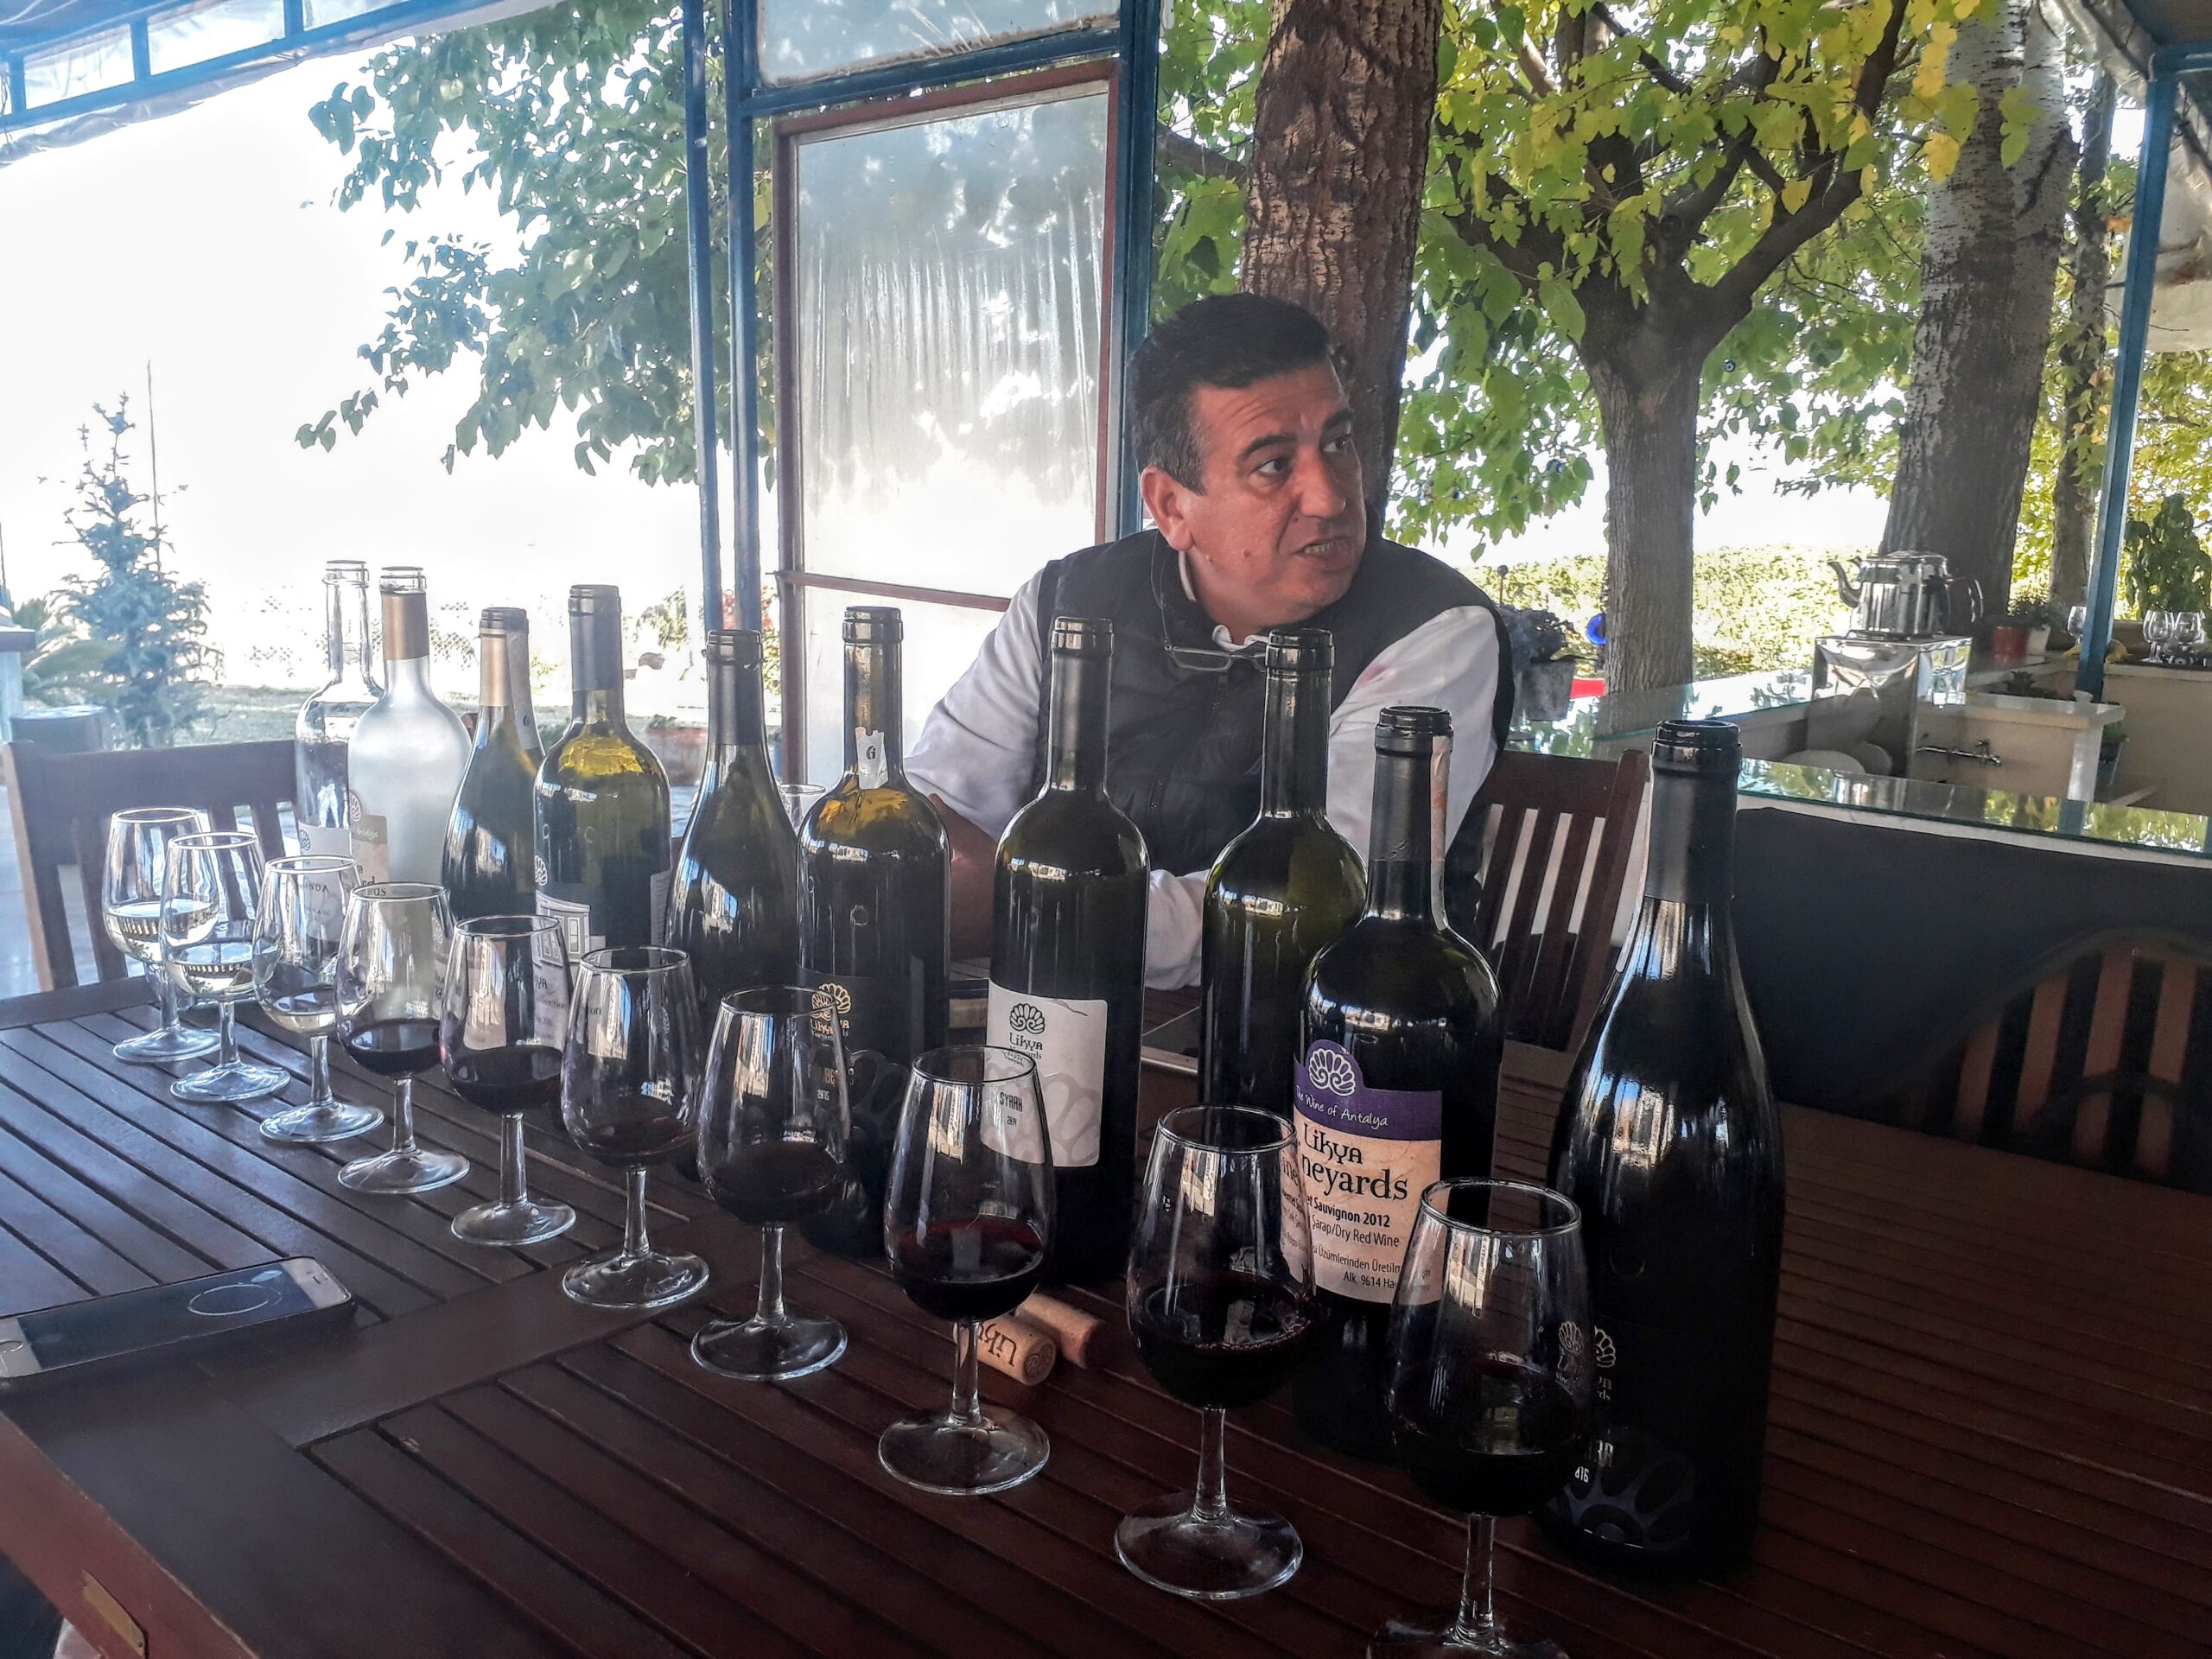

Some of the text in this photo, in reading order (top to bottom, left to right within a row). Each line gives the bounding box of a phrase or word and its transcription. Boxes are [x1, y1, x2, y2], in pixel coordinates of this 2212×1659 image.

[1305, 1094, 1325, 1112] Wine
[1327, 1105, 1338, 1117] of
[1340, 1109, 1389, 1130] Antalya
[1301, 1154, 1408, 1201] neyards
[1313, 1197, 1360, 1224] Sauvignon
[1363, 1211, 1390, 1227] 2012
[1353, 1229, 1371, 1244] Red
[1374, 1232, 1400, 1247] Wine
[1318, 1245, 1370, 1271] Üzümlerinden
[1343, 1271, 1358, 1284] Alk.
[1361, 1274, 1381, 1287] %14
